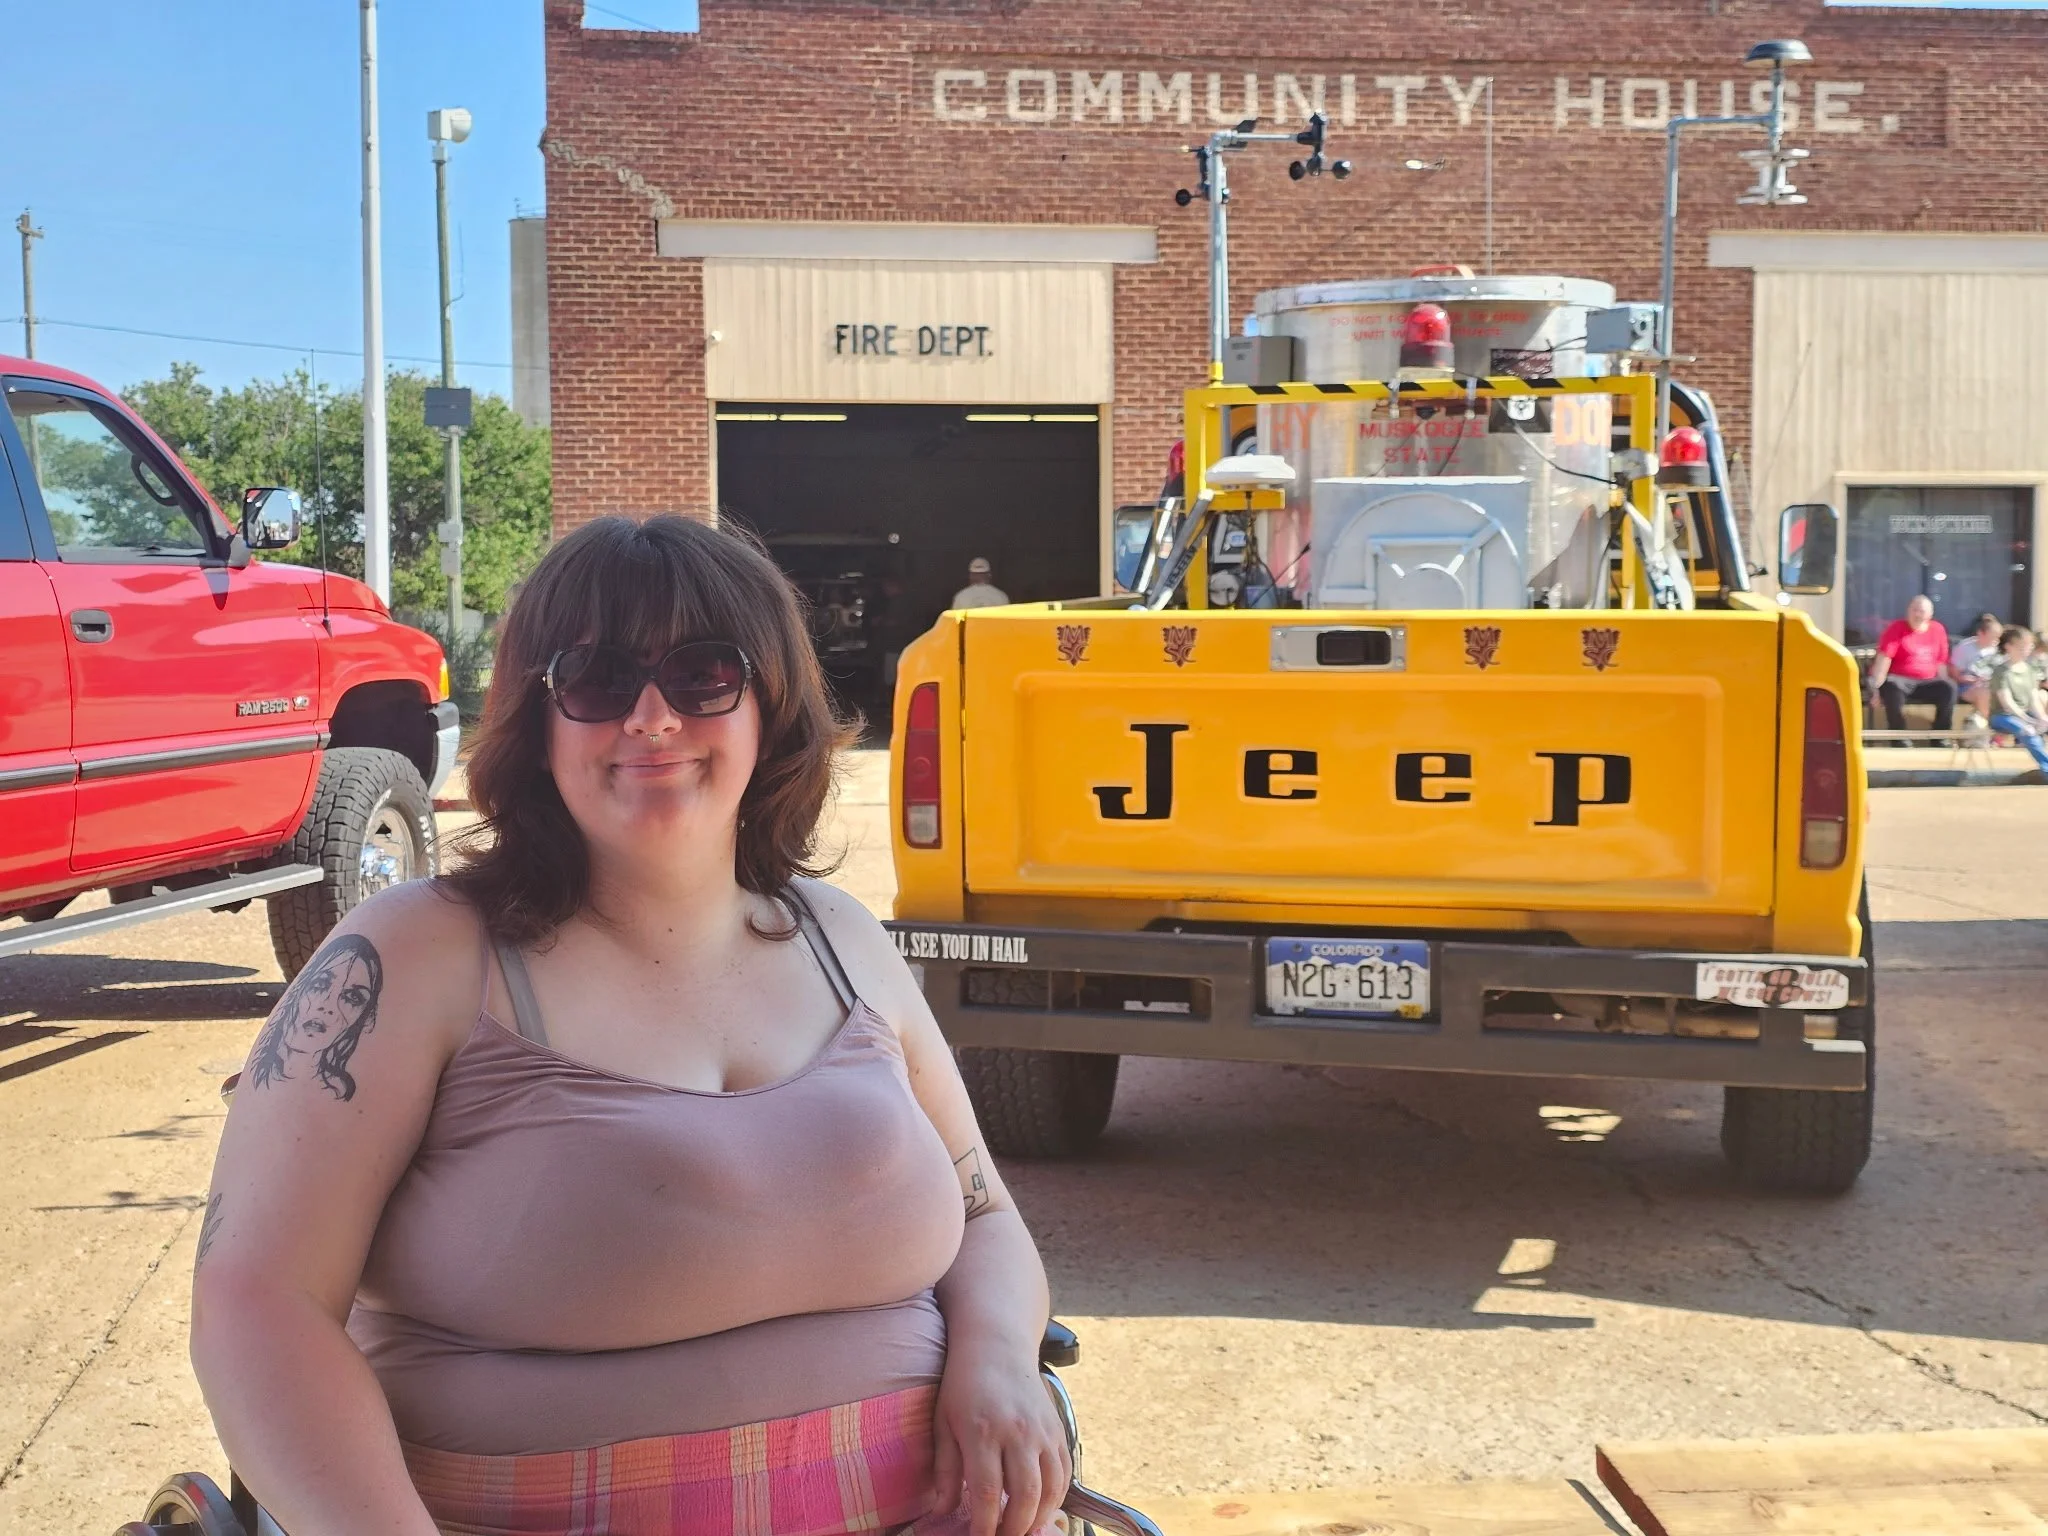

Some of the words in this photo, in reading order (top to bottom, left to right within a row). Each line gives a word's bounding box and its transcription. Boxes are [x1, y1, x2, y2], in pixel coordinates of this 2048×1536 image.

[933, 69, 1489, 127] COMMUNITY
[1554, 76, 1899, 134] HOUSE.
[836, 324, 897, 355] FIRE
[918, 325, 994, 356] DEPT.
[1360, 420, 1487, 439] MUSKOGEE
[1383, 446, 1463, 465] STATE
[238, 702, 261, 717] RAM
[261, 698, 290, 713] 2500
[1092, 723, 1632, 827] Jeep
[910, 932, 939, 959] SEE
[940, 933, 970, 960] YOU
[971, 934, 989, 962] IN
[991, 935, 1028, 963] HAIL
[1311, 944, 1384, 957] COLORADO
